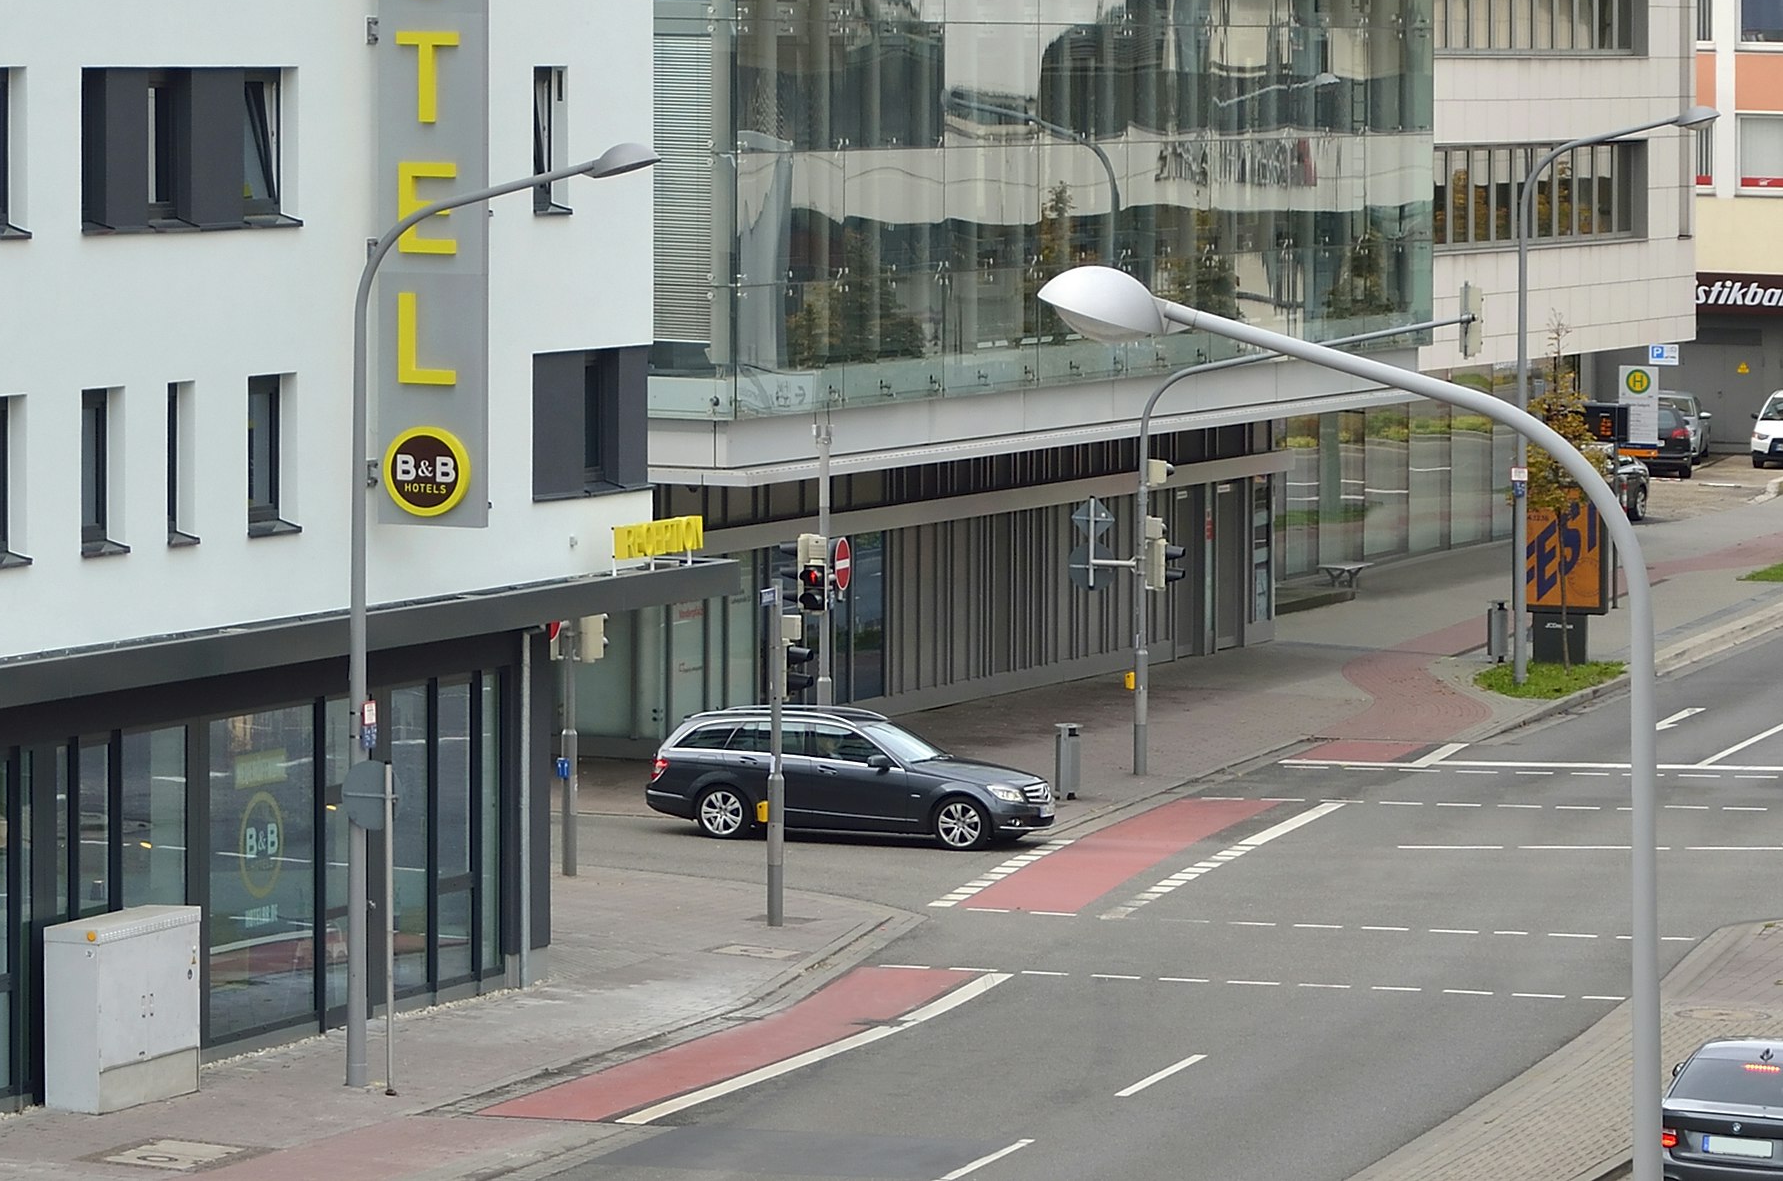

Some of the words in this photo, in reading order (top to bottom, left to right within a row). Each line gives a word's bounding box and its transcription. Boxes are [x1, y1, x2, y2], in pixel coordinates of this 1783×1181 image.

[1695, 280, 1783, 306] stikba
[1653, 347, 1662, 358] P
[1633, 374, 1643, 388] H
[396, 454, 456, 483] B&B
[404, 483, 447, 494] HOTELS
[626, 515, 704, 557] RECEPTION
[246, 822, 278, 857] B&B
